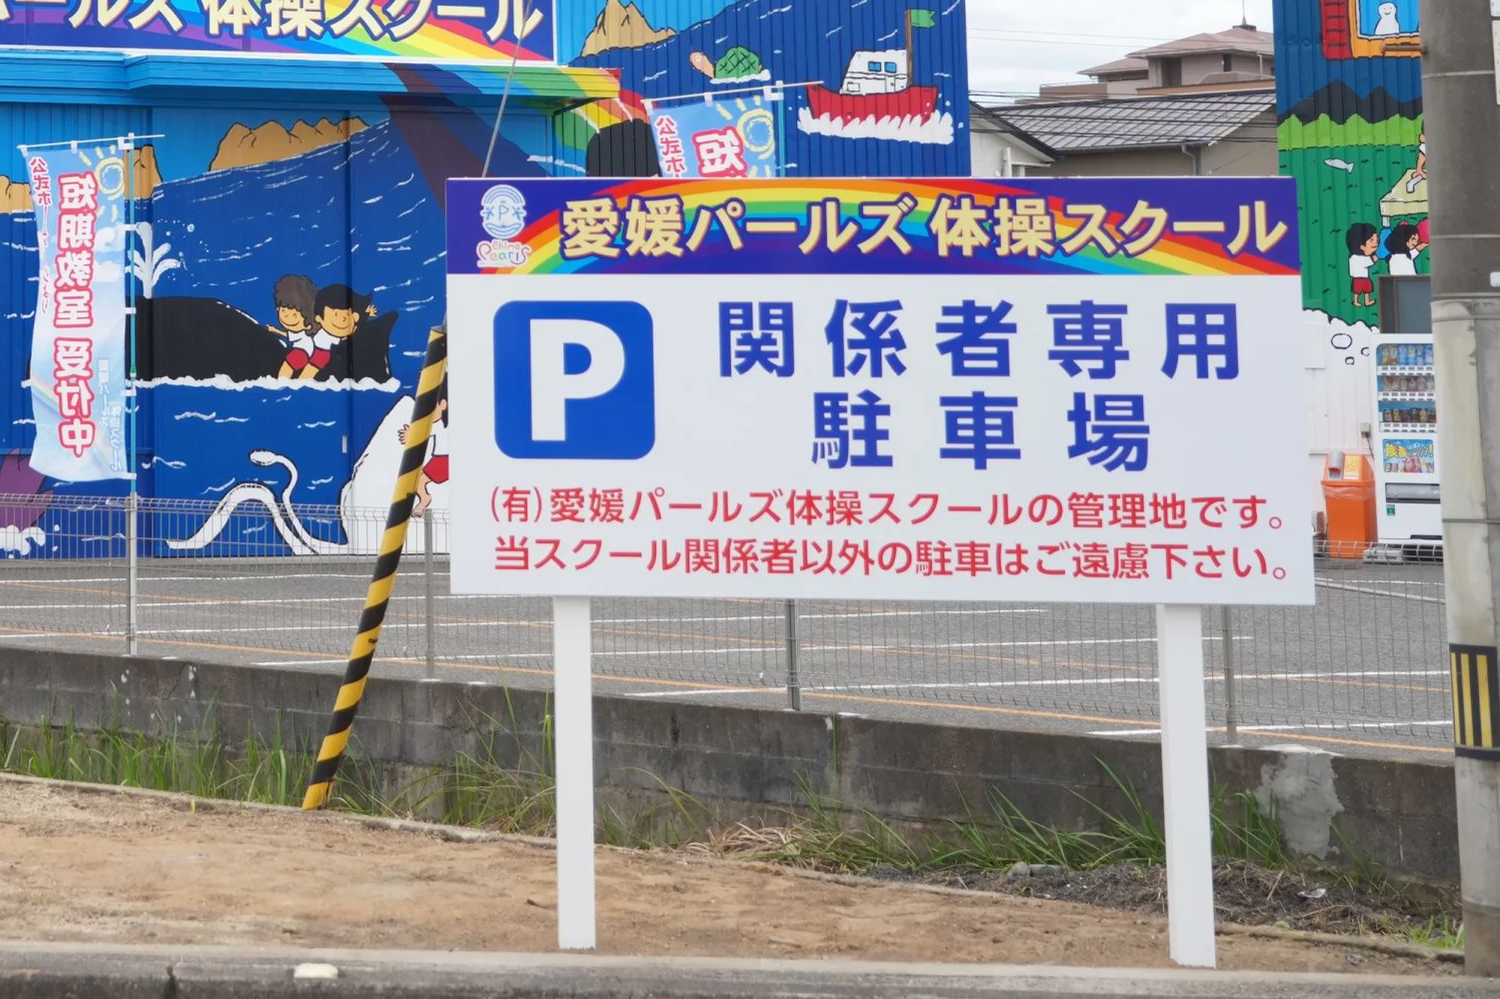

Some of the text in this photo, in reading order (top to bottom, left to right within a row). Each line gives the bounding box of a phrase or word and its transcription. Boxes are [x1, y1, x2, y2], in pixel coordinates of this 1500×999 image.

[561, 197, 1288, 258] 愛媛パールズ体操スクール
[718, 299, 1241, 380] 関係者専用
[811, 389, 1152, 471] 駐車場
[494, 535, 1287, 580] 当スクール関係者以外の駐車はご遠慮下さい。
